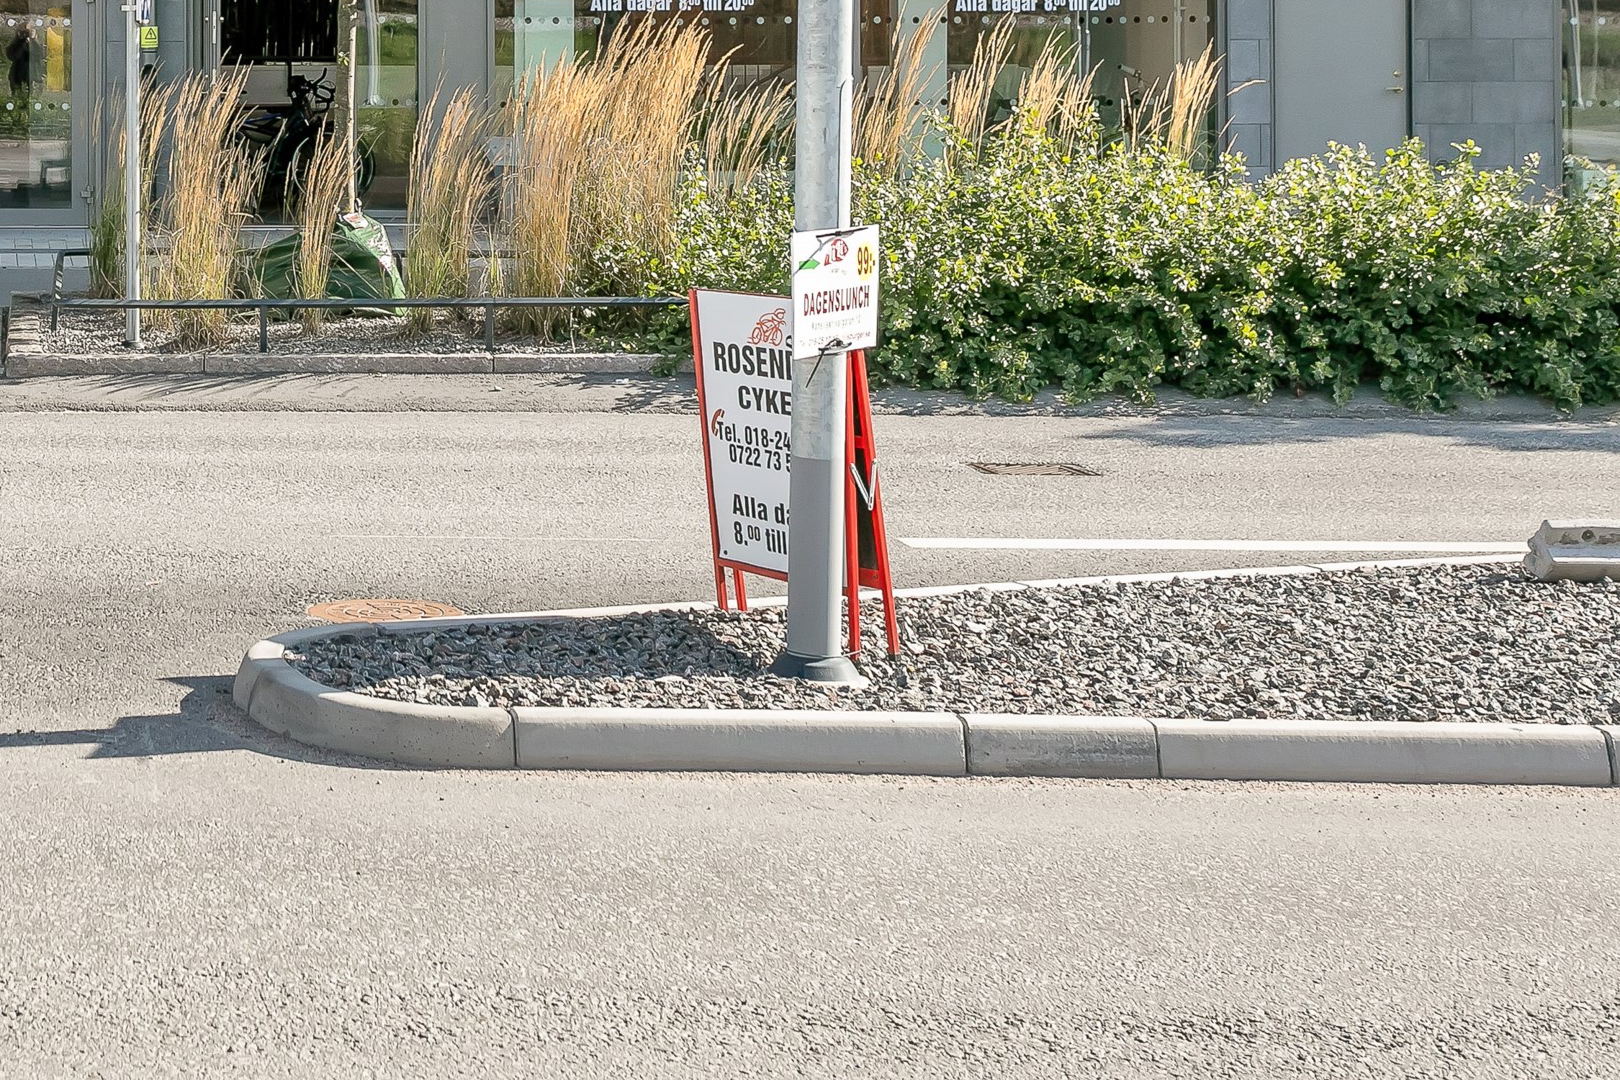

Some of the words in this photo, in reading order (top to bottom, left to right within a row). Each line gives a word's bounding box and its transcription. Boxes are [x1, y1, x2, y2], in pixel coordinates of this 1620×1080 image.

[803, 285, 870, 316] DAGENSLUNCH
[716, 421, 741, 443] Tel.
[729, 443, 762, 467] 0722
[764, 449, 782, 471] 73
[732, 493, 768, 521] Alla
[765, 528, 787, 555] till
